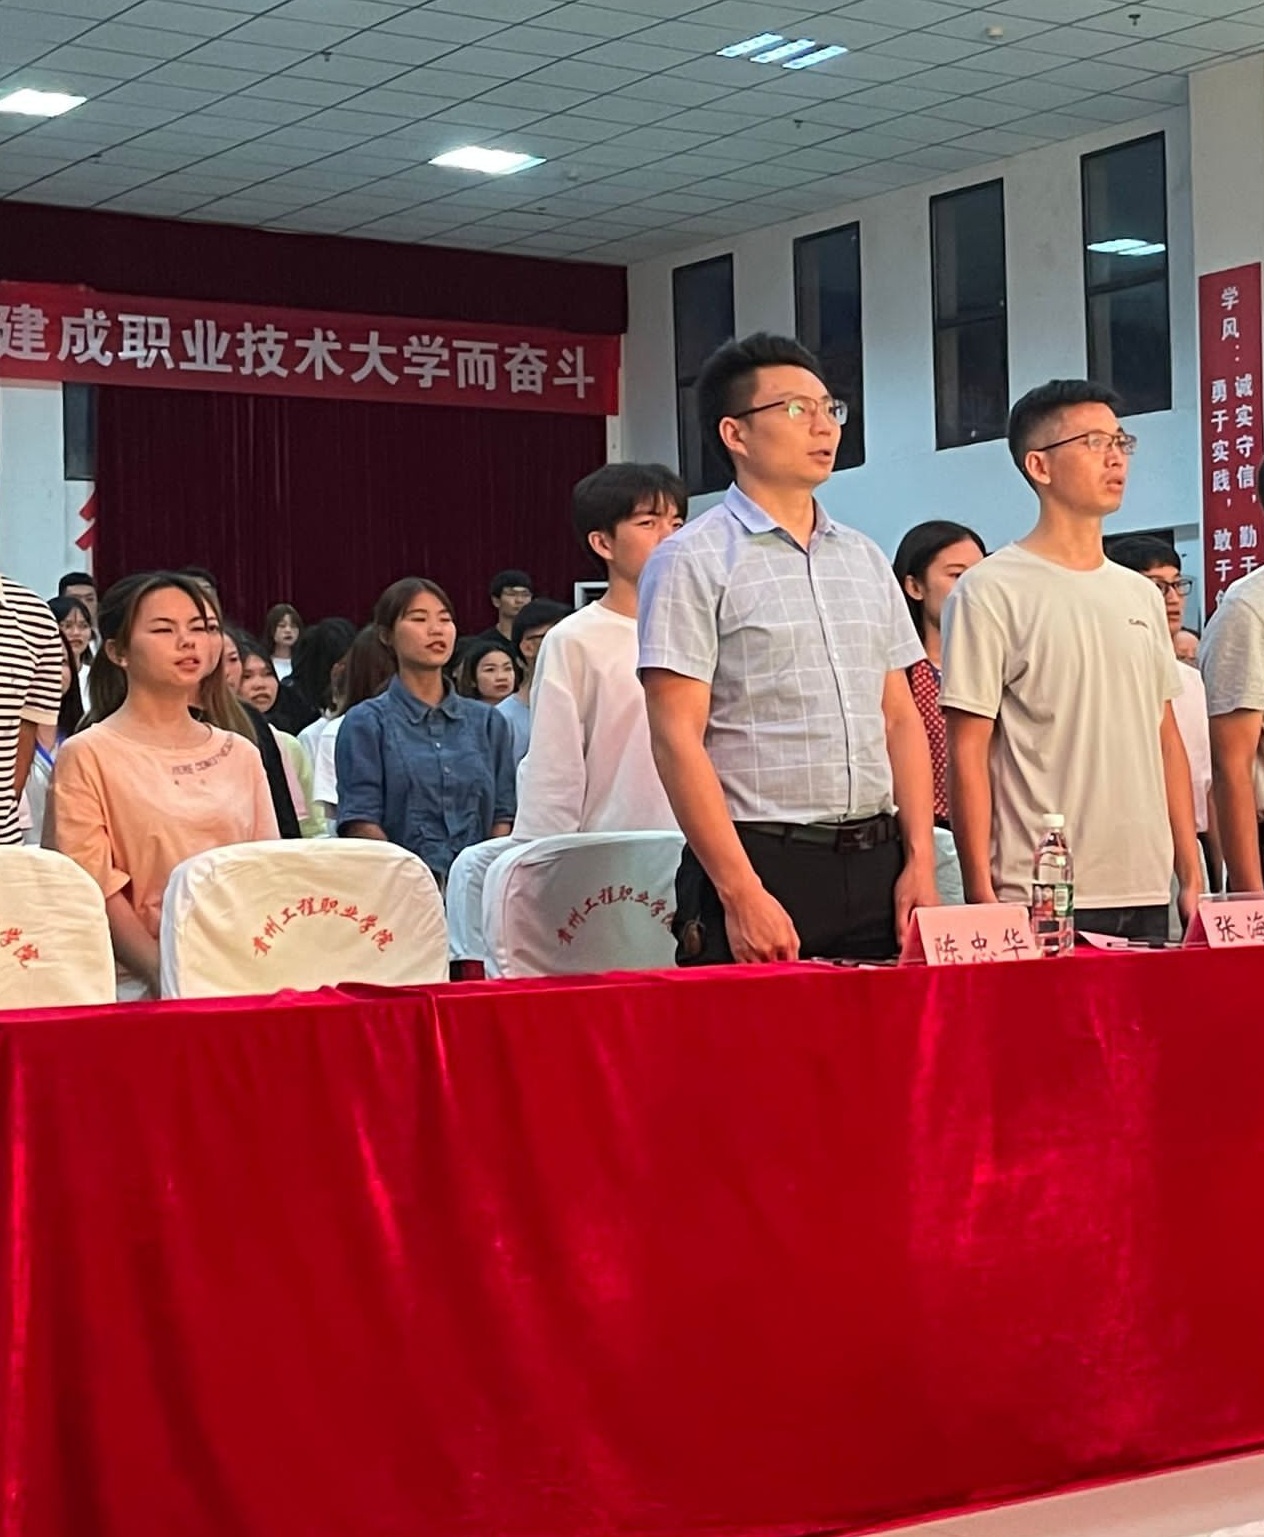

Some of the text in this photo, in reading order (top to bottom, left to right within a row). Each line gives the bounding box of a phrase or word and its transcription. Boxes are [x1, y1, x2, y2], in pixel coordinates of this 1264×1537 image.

[0, 303, 596, 398] 建成职业技术大学而奋斗
[253, 897, 394, 957] 贵州工程职业学院
